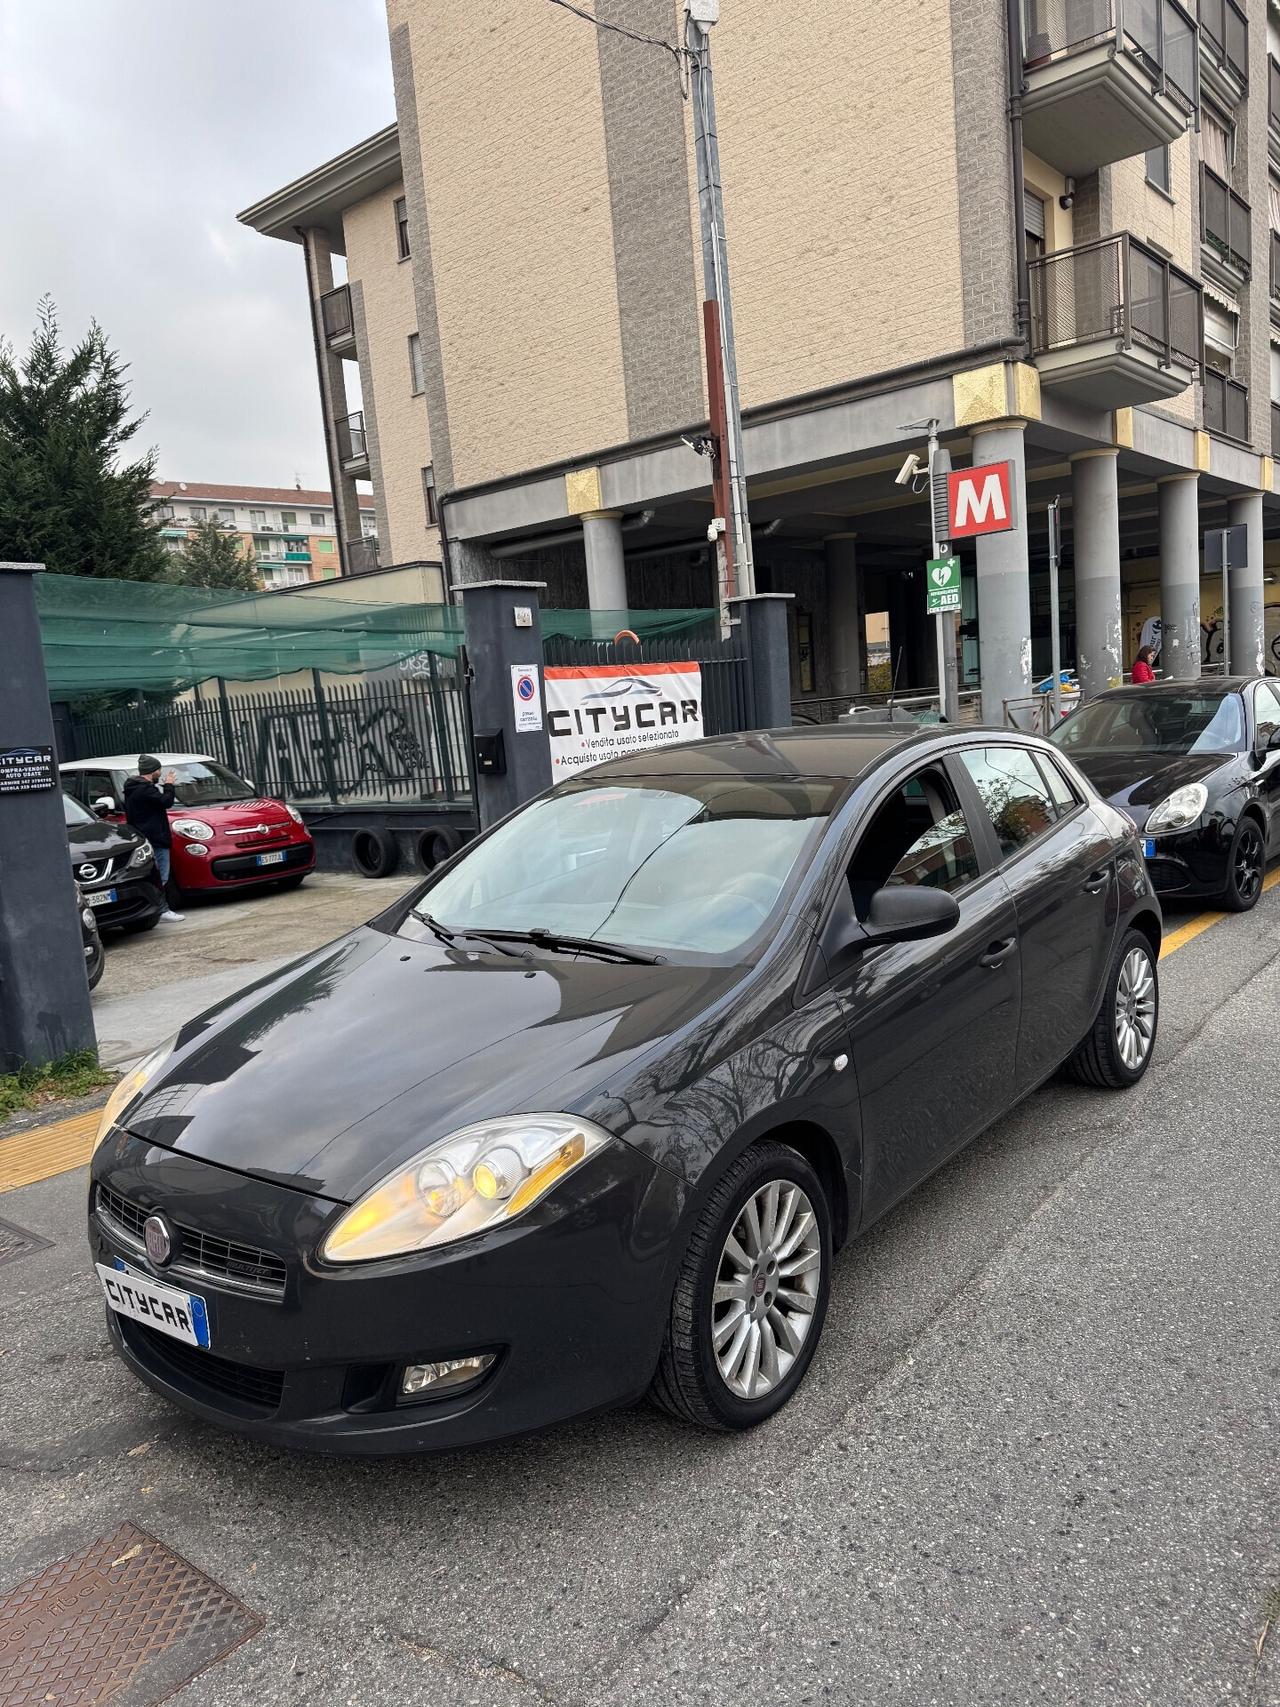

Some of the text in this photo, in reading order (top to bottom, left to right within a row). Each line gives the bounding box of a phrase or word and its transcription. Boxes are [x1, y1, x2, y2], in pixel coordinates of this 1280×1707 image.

[954, 473, 1007, 528] M
[941, 593, 959, 606] AED
[547, 699, 699, 738] CITYCAR
[585, 737, 615, 749] Vendita
[616, 735, 637, 746] usato
[638, 729, 679, 743] selezionato
[0, 755, 52, 766] ITYCAR
[561, 750, 619, 766] Acquisto usato
[105, 1278, 192, 1333] CITYCAR
[47, 1580, 102, 1617] fiber
